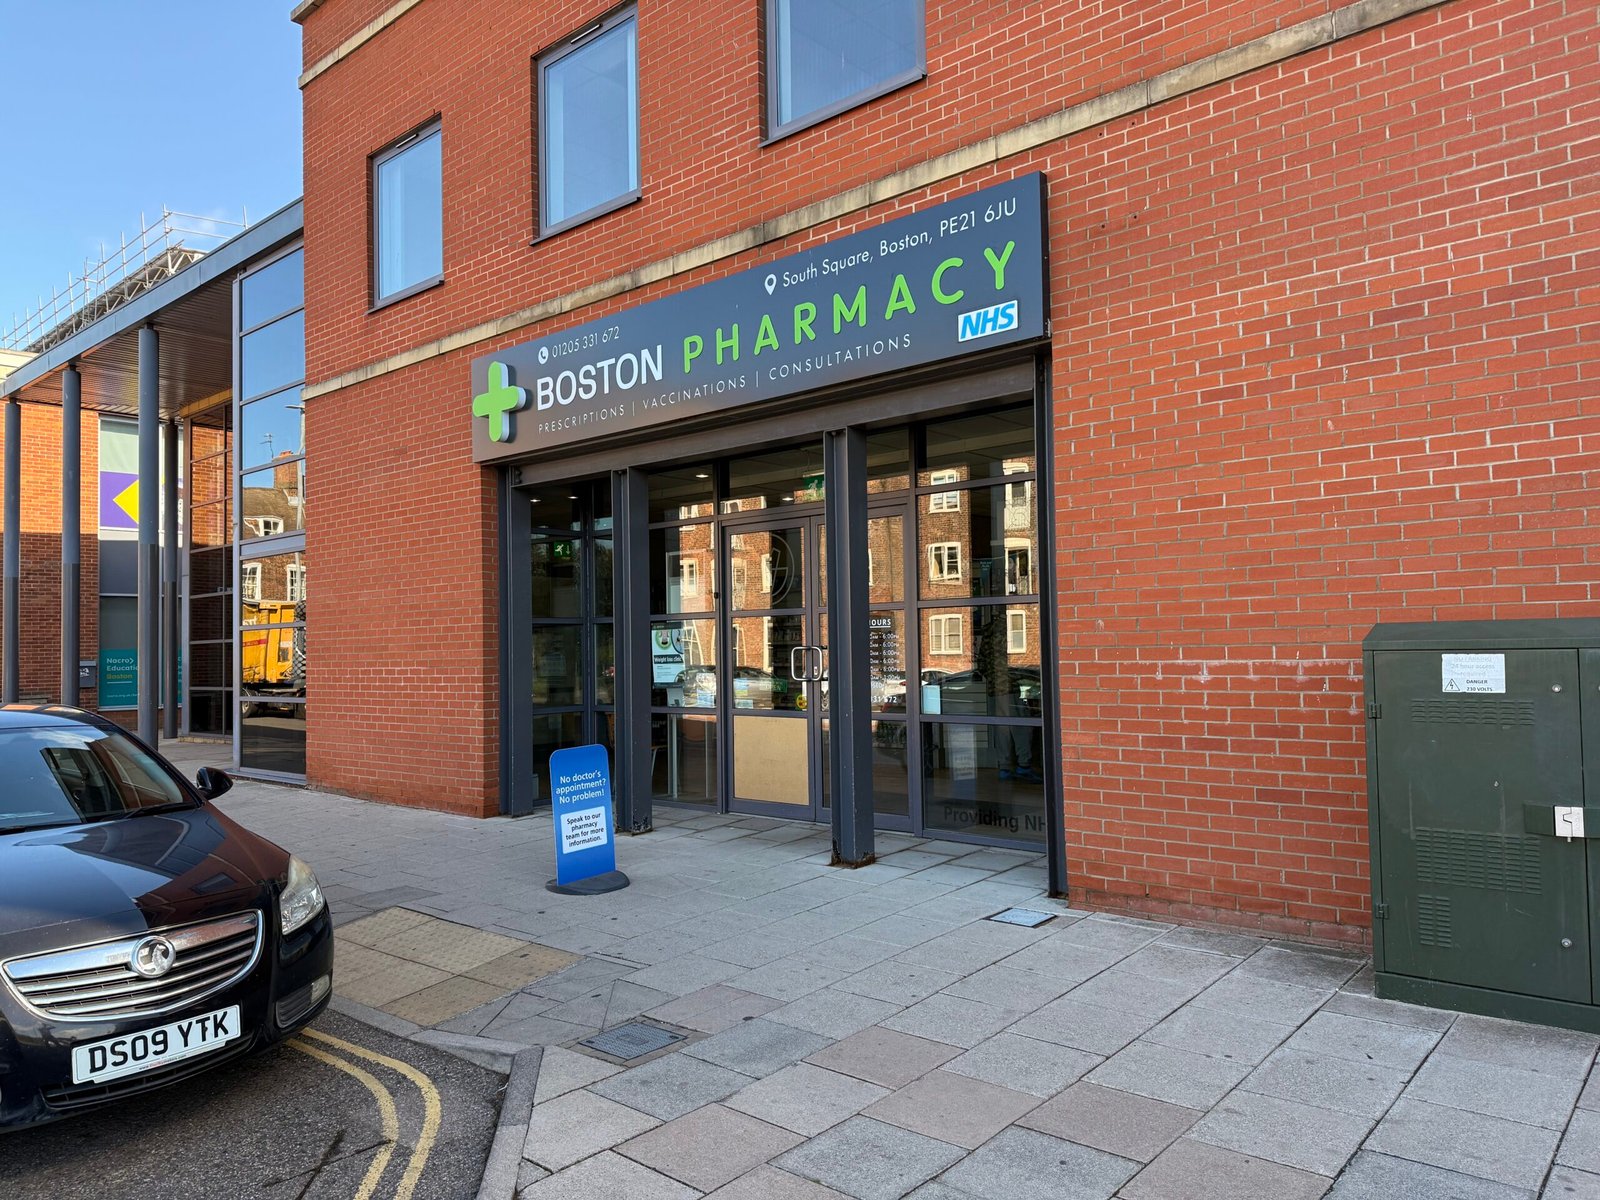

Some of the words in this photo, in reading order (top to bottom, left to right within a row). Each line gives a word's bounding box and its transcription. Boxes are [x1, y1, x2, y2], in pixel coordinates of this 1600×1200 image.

[782, 263, 818, 287] South
[822, 251, 874, 276] Square,
[880, 231, 933, 257] Boston,
[940, 211, 975, 237] PE21
[984, 197, 1016, 223] 6JU
[536, 344, 663, 411] BOSTON
[683, 240, 1015, 374] PHARMACY
[960, 303, 1016, 339] NHS
[552, 338, 580, 358] 01205
[582, 333, 598, 349] 331
[602, 326, 620, 343] 672
[538, 404, 625, 434] PRESCRIPTIONS
[642, 375, 746, 409] VACCINATIONS
[769, 334, 911, 381] CONSULTATIONS
[556, 778, 607, 795] appointment?
[560, 776, 571, 784] No
[559, 796, 570, 804] No
[572, 789, 605, 803] problem!
[566, 815, 583, 825] Speak
[571, 821, 598, 832] pharmacy
[943, 805, 1019, 833] Providing
[1025, 815, 1046, 831] NH
[568, 836, 602, 847] information.
[88, 1029, 169, 1074] DS09
[177, 1011, 229, 1048] YTK
